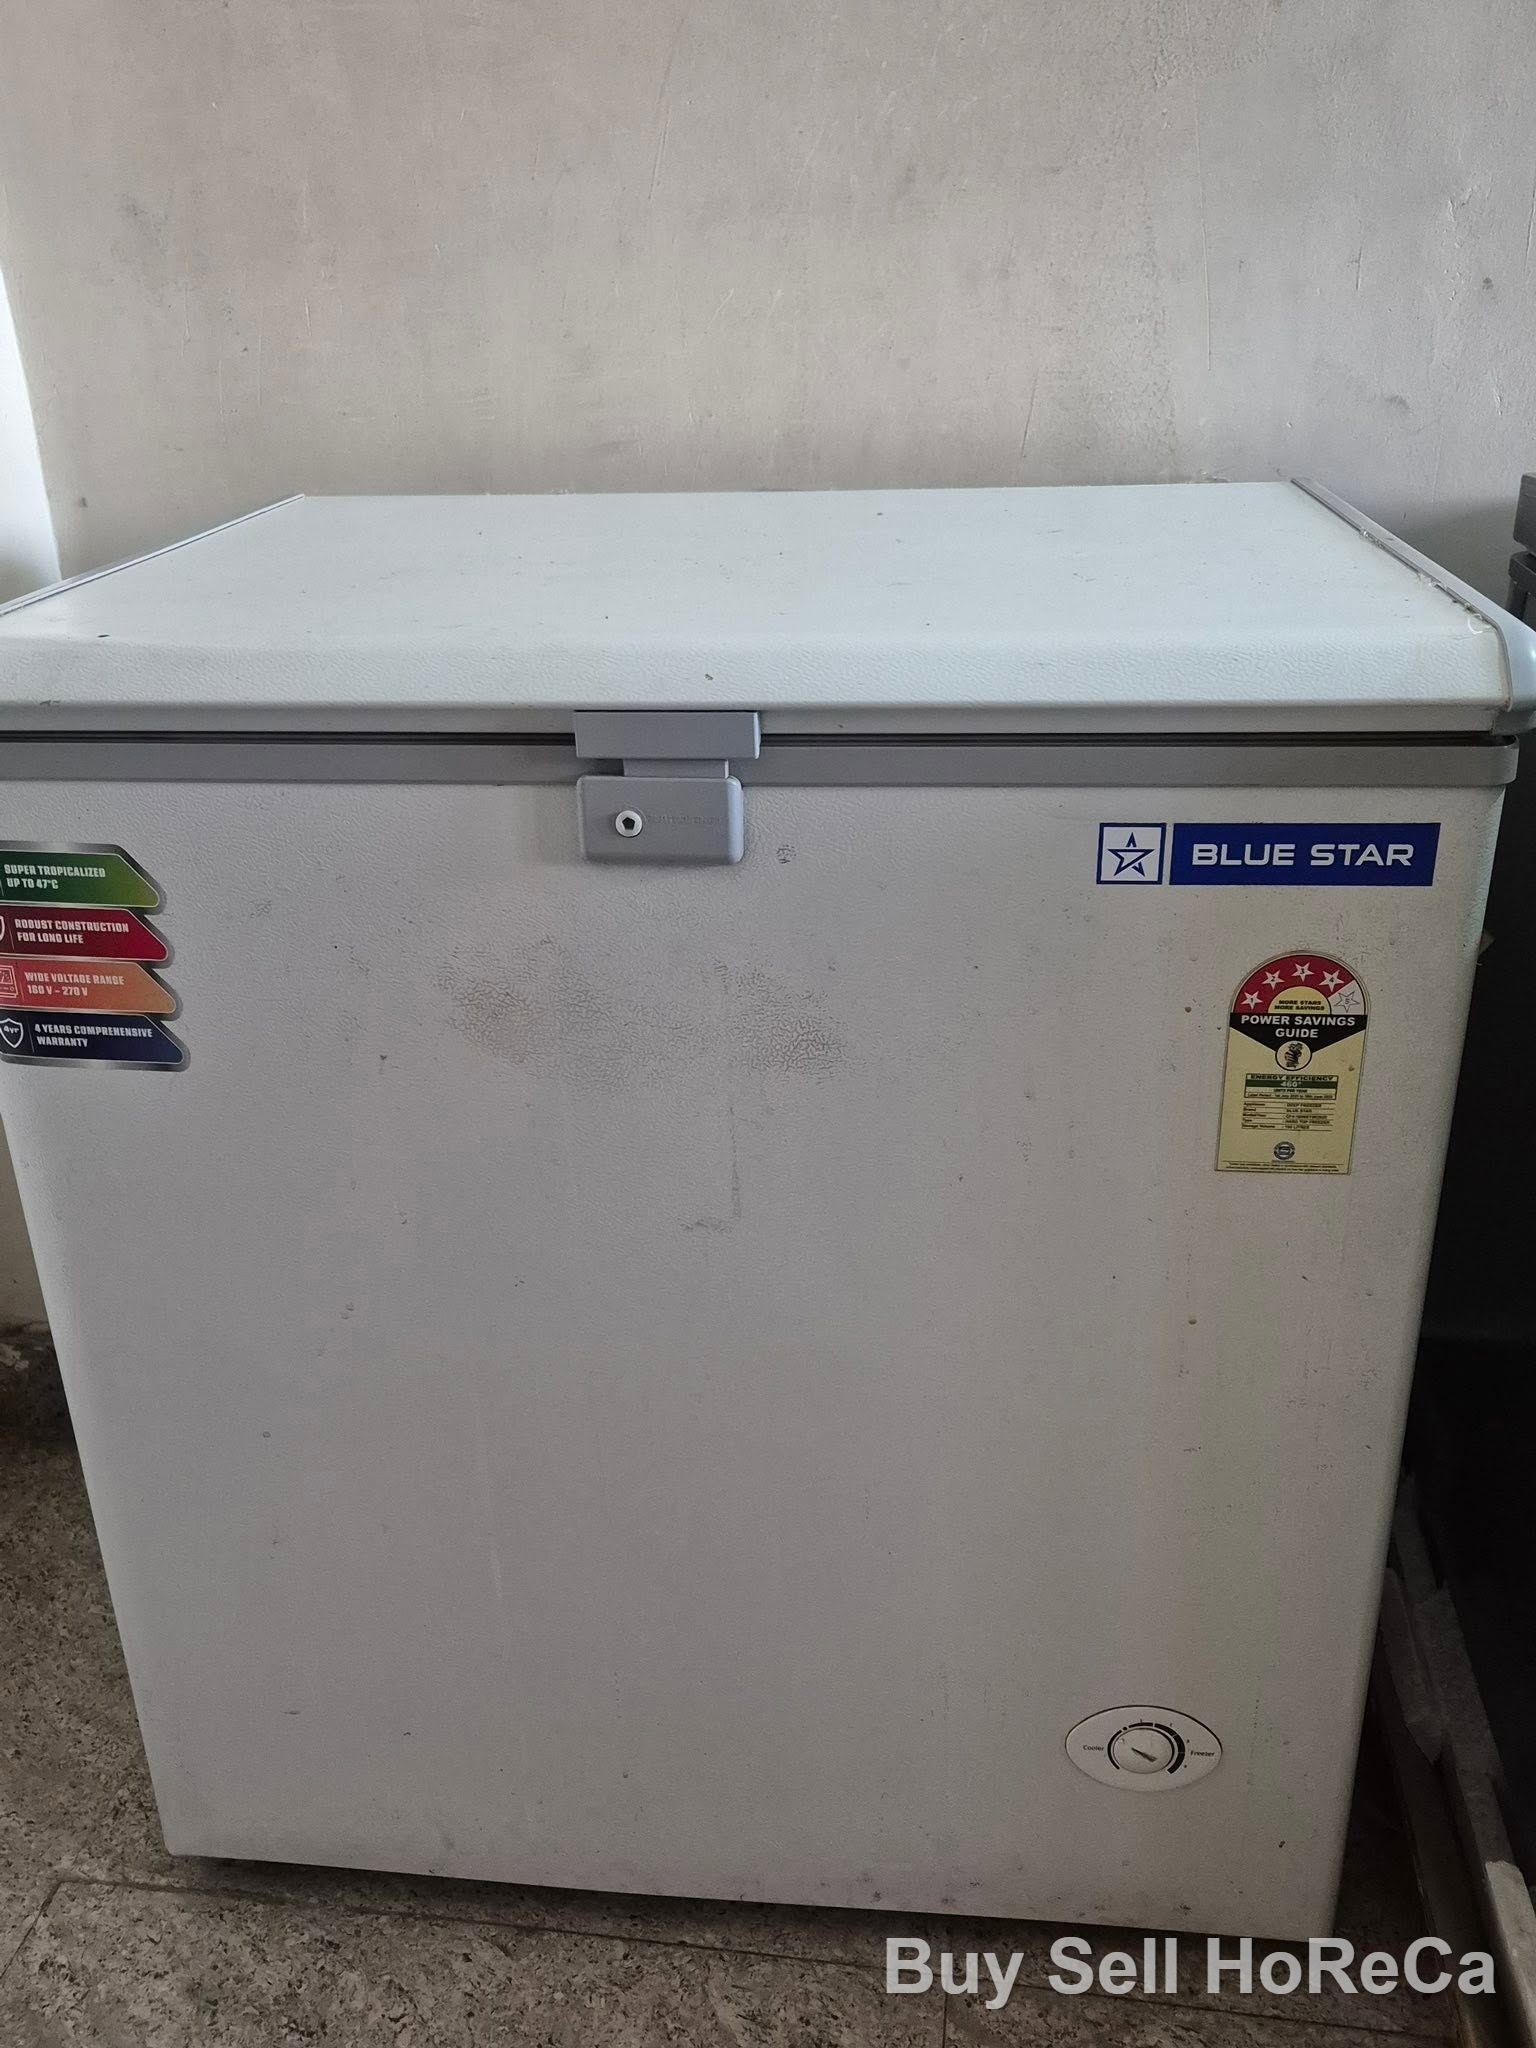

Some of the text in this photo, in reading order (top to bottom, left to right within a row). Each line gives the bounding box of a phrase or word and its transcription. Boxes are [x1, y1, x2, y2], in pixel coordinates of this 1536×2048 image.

[1192, 843, 1414, 866] BLUE STAR
[4, 864, 106, 878] SUPER TROPICALIZED
[7, 878, 20, 888] UP
[22, 878, 34, 889] TO
[15, 918, 129, 932] ROBUST CONSTRUCTION
[17, 932, 84, 944] FOR LONG LIFE
[24, 972, 125, 985] WIDE VOLTAGE RANGE
[47, 986, 52, 995] V
[62, 986, 80, 996] 270
[81, 987, 88, 996] V
[1241, 1015, 1356, 1026] POWER SAVINGS
[34, 1024, 153, 1038] 4 YEARS COMPREHENSIVE
[1275, 1028, 1319, 1038] GUIDE
[36, 1036, 88, 1047] WARRANTY
